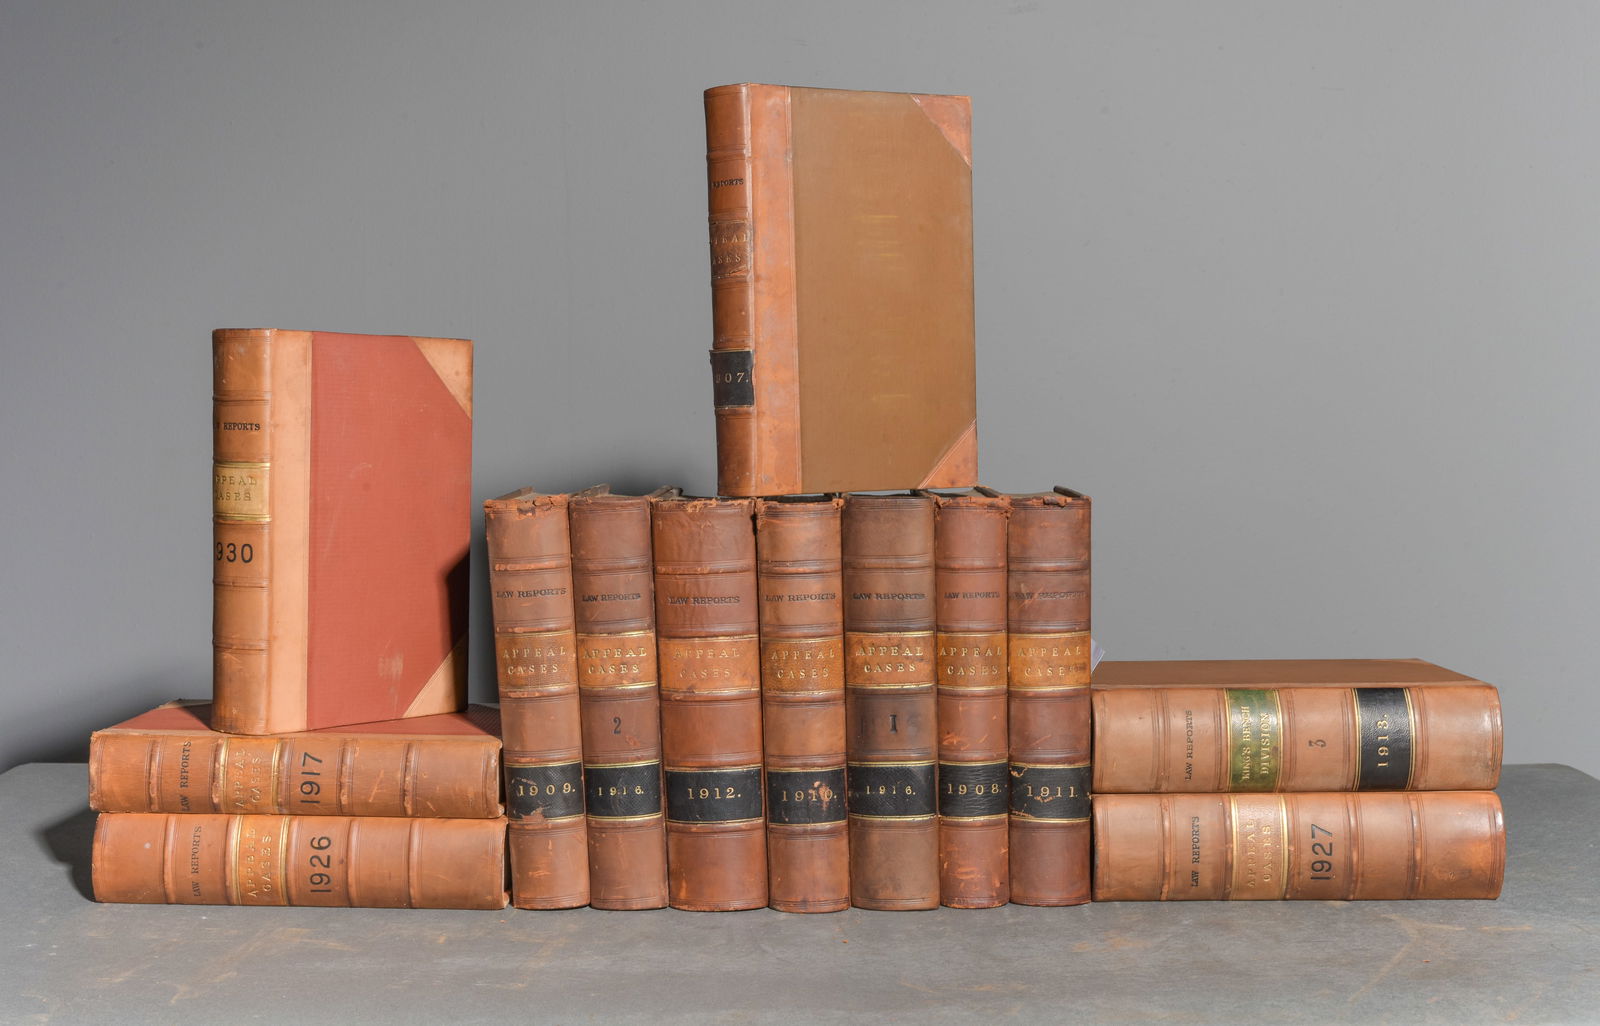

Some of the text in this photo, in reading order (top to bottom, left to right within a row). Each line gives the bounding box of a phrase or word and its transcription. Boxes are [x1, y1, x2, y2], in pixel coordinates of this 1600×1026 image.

[223, 422, 261, 432] REPORTS
[215, 475, 257, 486] PPEAL
[215, 491, 252, 502] ASES
[215, 542, 253, 564] 930
[496, 586, 567, 599] LAW REPORTS
[581, 592, 641, 603] LAW REPORTS
[765, 592, 837, 603] LAW REPORTS
[852, 592, 925, 601] LAW REPORTS
[944, 591, 1001, 600] LAW REPORTS
[669, 595, 741, 606] LAW REPORTS
[502, 645, 567, 659] APPEAL
[582, 646, 648, 659] APPEAL
[673, 646, 741, 659] APPEAL
[771, 647, 835, 660] APPEAL
[855, 645, 924, 657] APPEAL
[939, 645, 1002, 657] APPEAL
[1017, 646, 1081, 657] APPEAL
[507, 662, 560, 676] CASES
[587, 663, 640, 676] CASES
[679, 667, 731, 680] CASES
[777, 667, 830, 679] CASES
[863, 662, 917, 674] CASES
[946, 664, 999, 676] CASES
[612, 716, 623, 735] 2
[1240, 706, 1251, 741] BENCH
[1185, 710, 1193, 780] LAW REPORTS
[1260, 712, 1271, 775] DIVISION
[1308, 739, 1327, 748] 3
[180, 741, 192, 789] REPORTS
[234, 748, 246, 808] APPEAL
[251, 756, 263, 803] CASES
[300, 751, 323, 804] 1917
[518, 782, 576, 797] 1909.
[687, 786, 742, 800] 1912.
[1191, 816, 1200, 888] LAW REPORTS
[1247, 818, 1257, 888] APPEAL
[1262, 825, 1272, 882] CASES
[1310, 823, 1333, 881] 1927
[191, 825, 202, 897] LAW REPORTS
[246, 828, 258, 898] APPEAL
[261, 834, 272, 892] CASES
[309, 836, 332, 893] 1926
